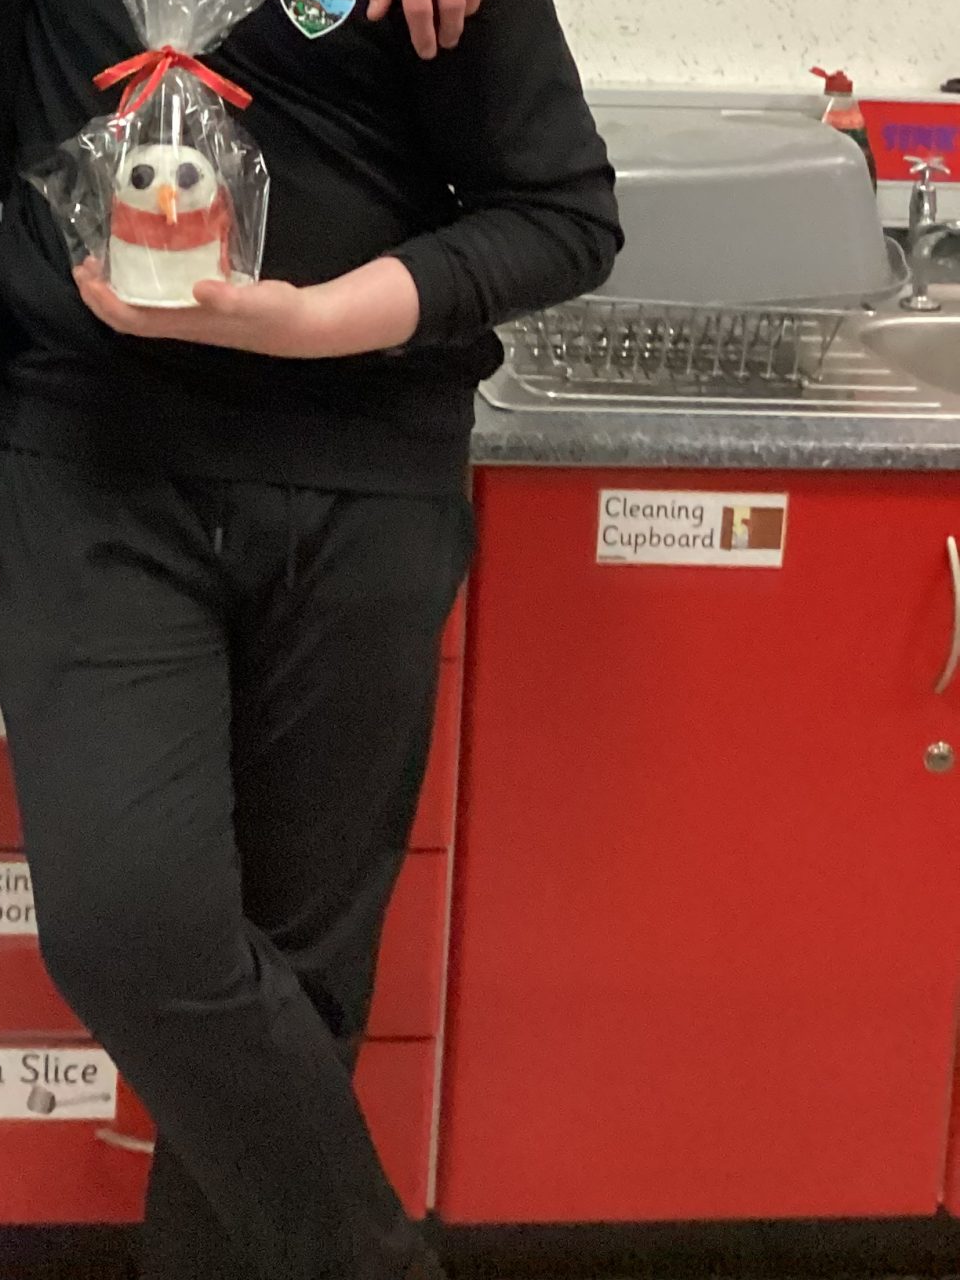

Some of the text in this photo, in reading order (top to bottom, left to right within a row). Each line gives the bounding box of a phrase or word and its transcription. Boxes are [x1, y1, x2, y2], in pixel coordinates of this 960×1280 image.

[604, 496, 705, 528] Cleaning
[602, 525, 715, 554] Cupboard
[19, 1053, 98, 1085] Slice
